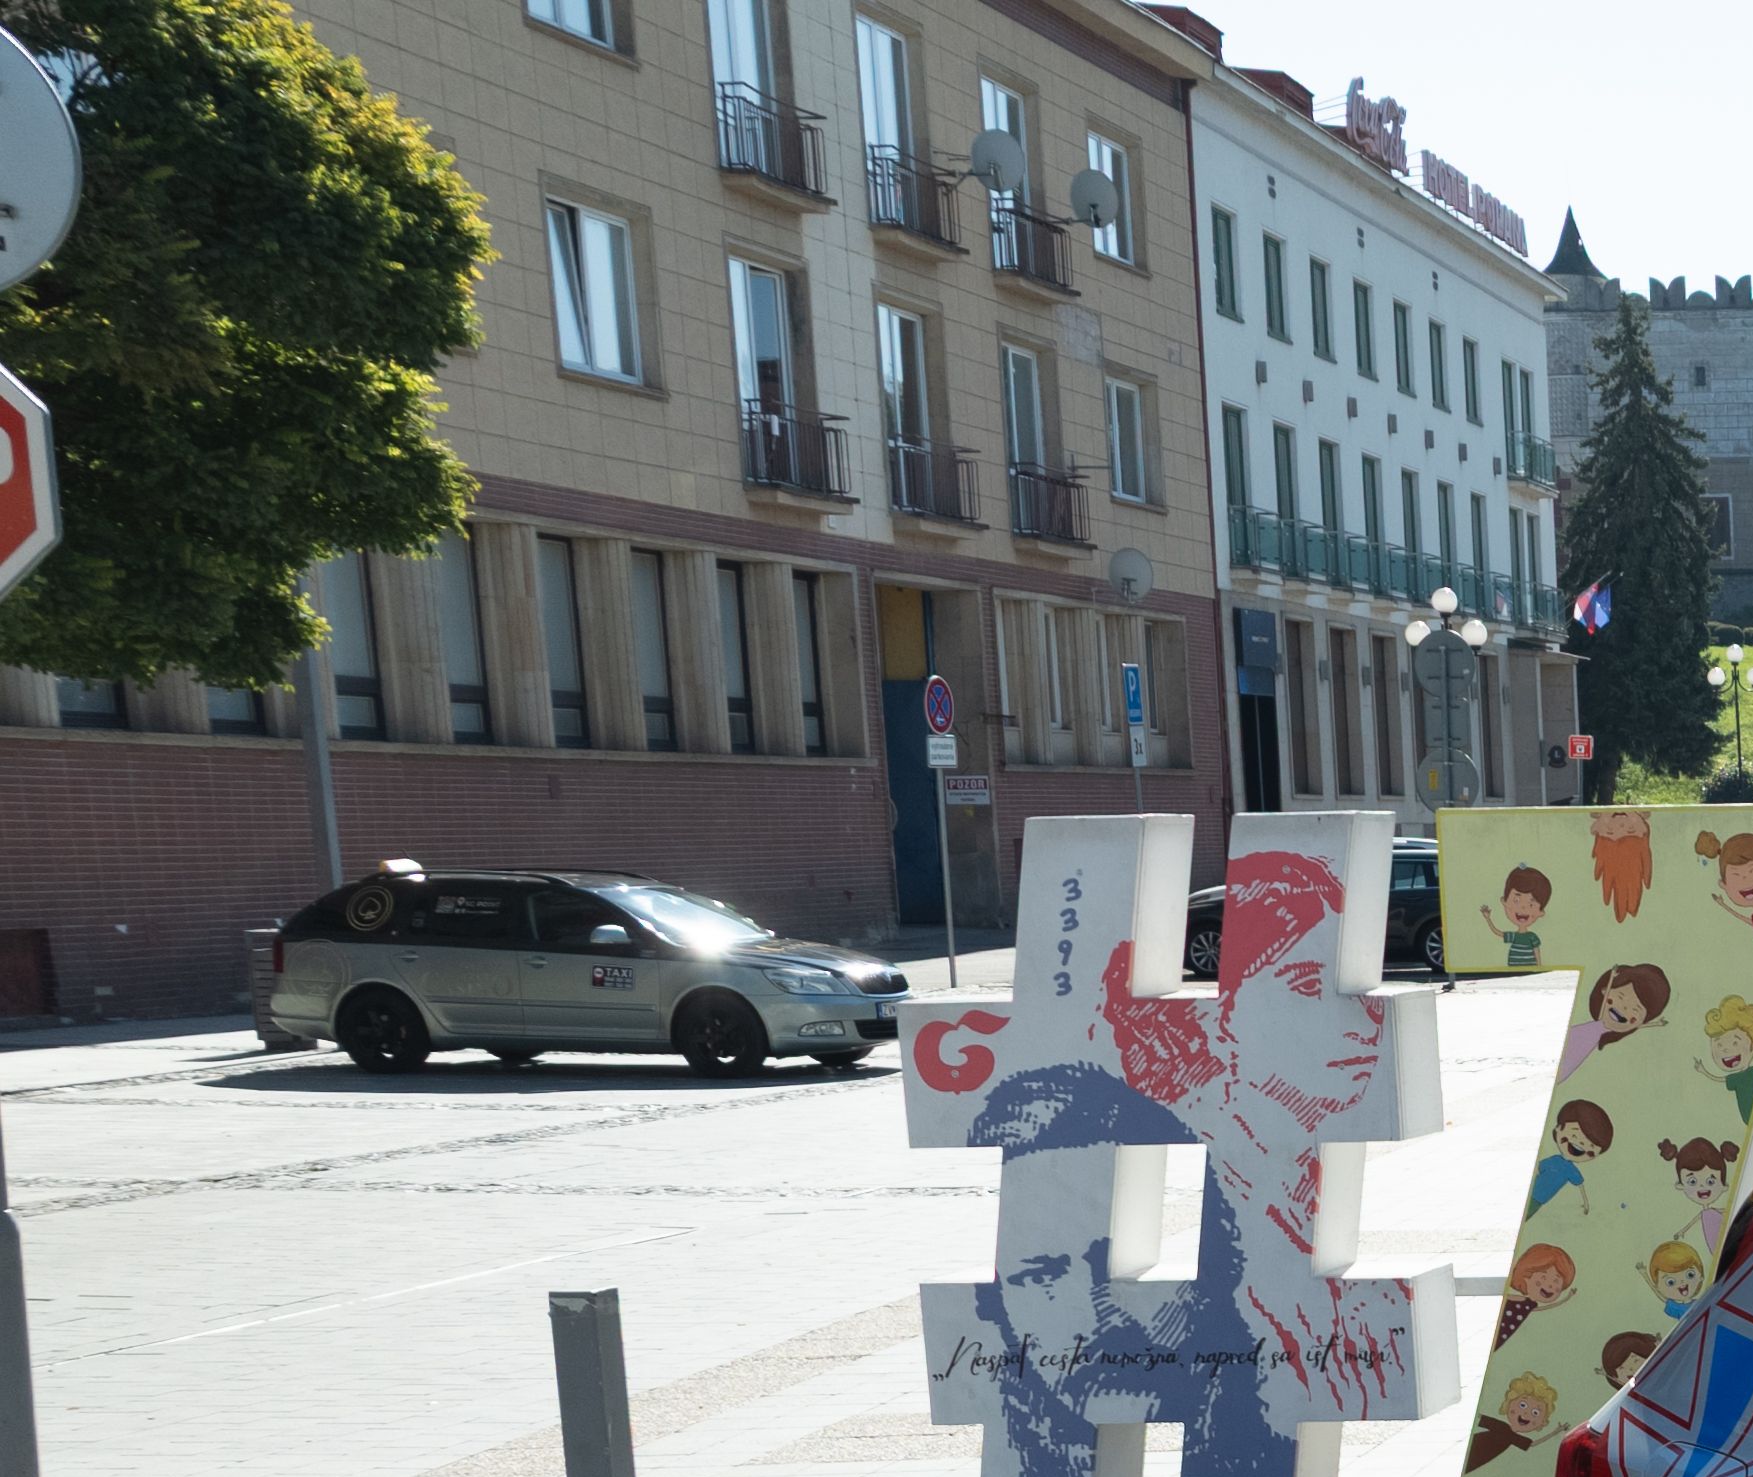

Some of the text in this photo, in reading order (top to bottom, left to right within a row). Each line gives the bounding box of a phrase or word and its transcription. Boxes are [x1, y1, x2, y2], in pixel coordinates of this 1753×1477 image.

[1421, 149, 1474, 219] HOTEL
[1128, 671, 1137, 703] P
[949, 778, 986, 790] POZOR
[604, 967, 633, 978] TAXI
[1039, 1334, 1092, 1375] cesta
[1270, 1351, 1294, 1370] sa
